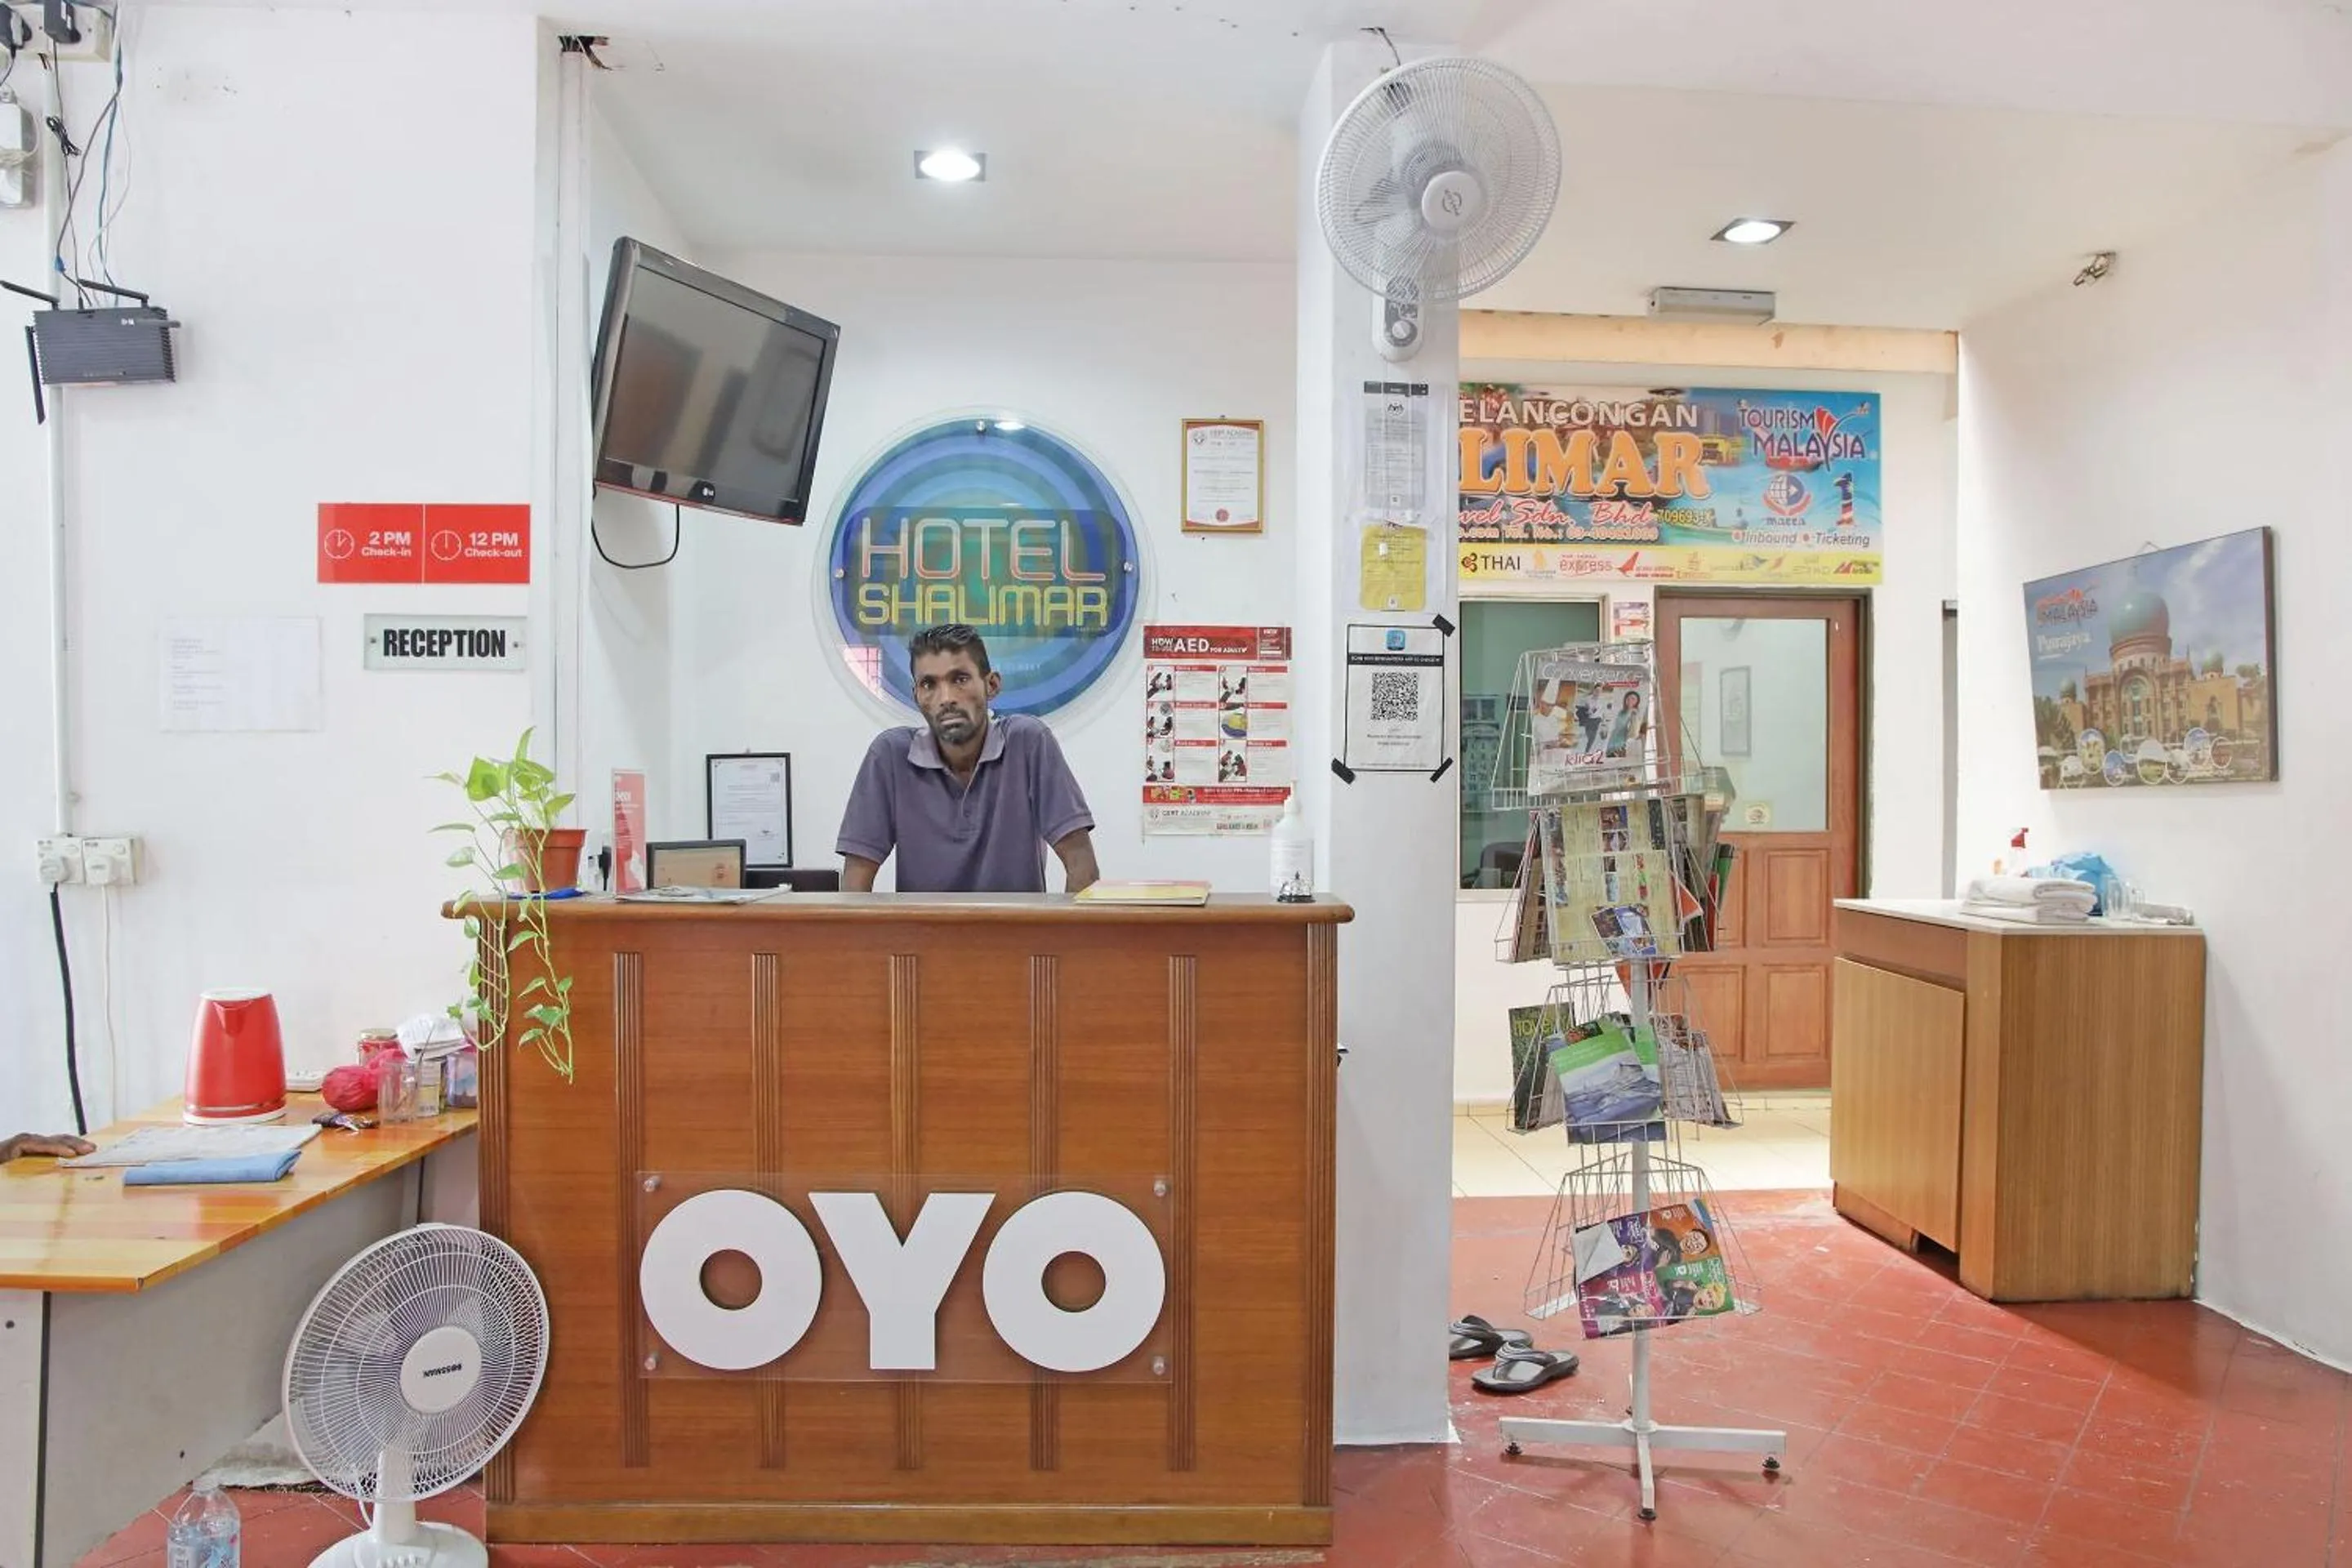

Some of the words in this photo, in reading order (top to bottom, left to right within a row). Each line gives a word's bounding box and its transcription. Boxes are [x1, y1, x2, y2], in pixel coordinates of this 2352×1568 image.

[1739, 408, 1815, 430] TOURISM
[1753, 430, 1866, 471] MALAYSIA
[1459, 428, 1712, 499] LIMAR
[1591, 500, 1654, 525] Bhd
[369, 532, 380, 546] 2
[384, 532, 412, 546] PM
[470, 532, 488, 546] 12
[492, 532, 519, 546] PM
[1816, 532, 1870, 547] Ticketing
[361, 546, 412, 557] Check-in
[464, 547, 523, 558] Check-out
[862, 517, 1106, 581] HOTEL
[1481, 555, 1521, 571] THAI
[1559, 558, 1613, 574] express
[858, 582, 1108, 627] SHALIMAR
[383, 629, 506, 657] RECEPTION
[1174, 637, 1209, 653] AED
[639, 1188, 1167, 1373] OYO
